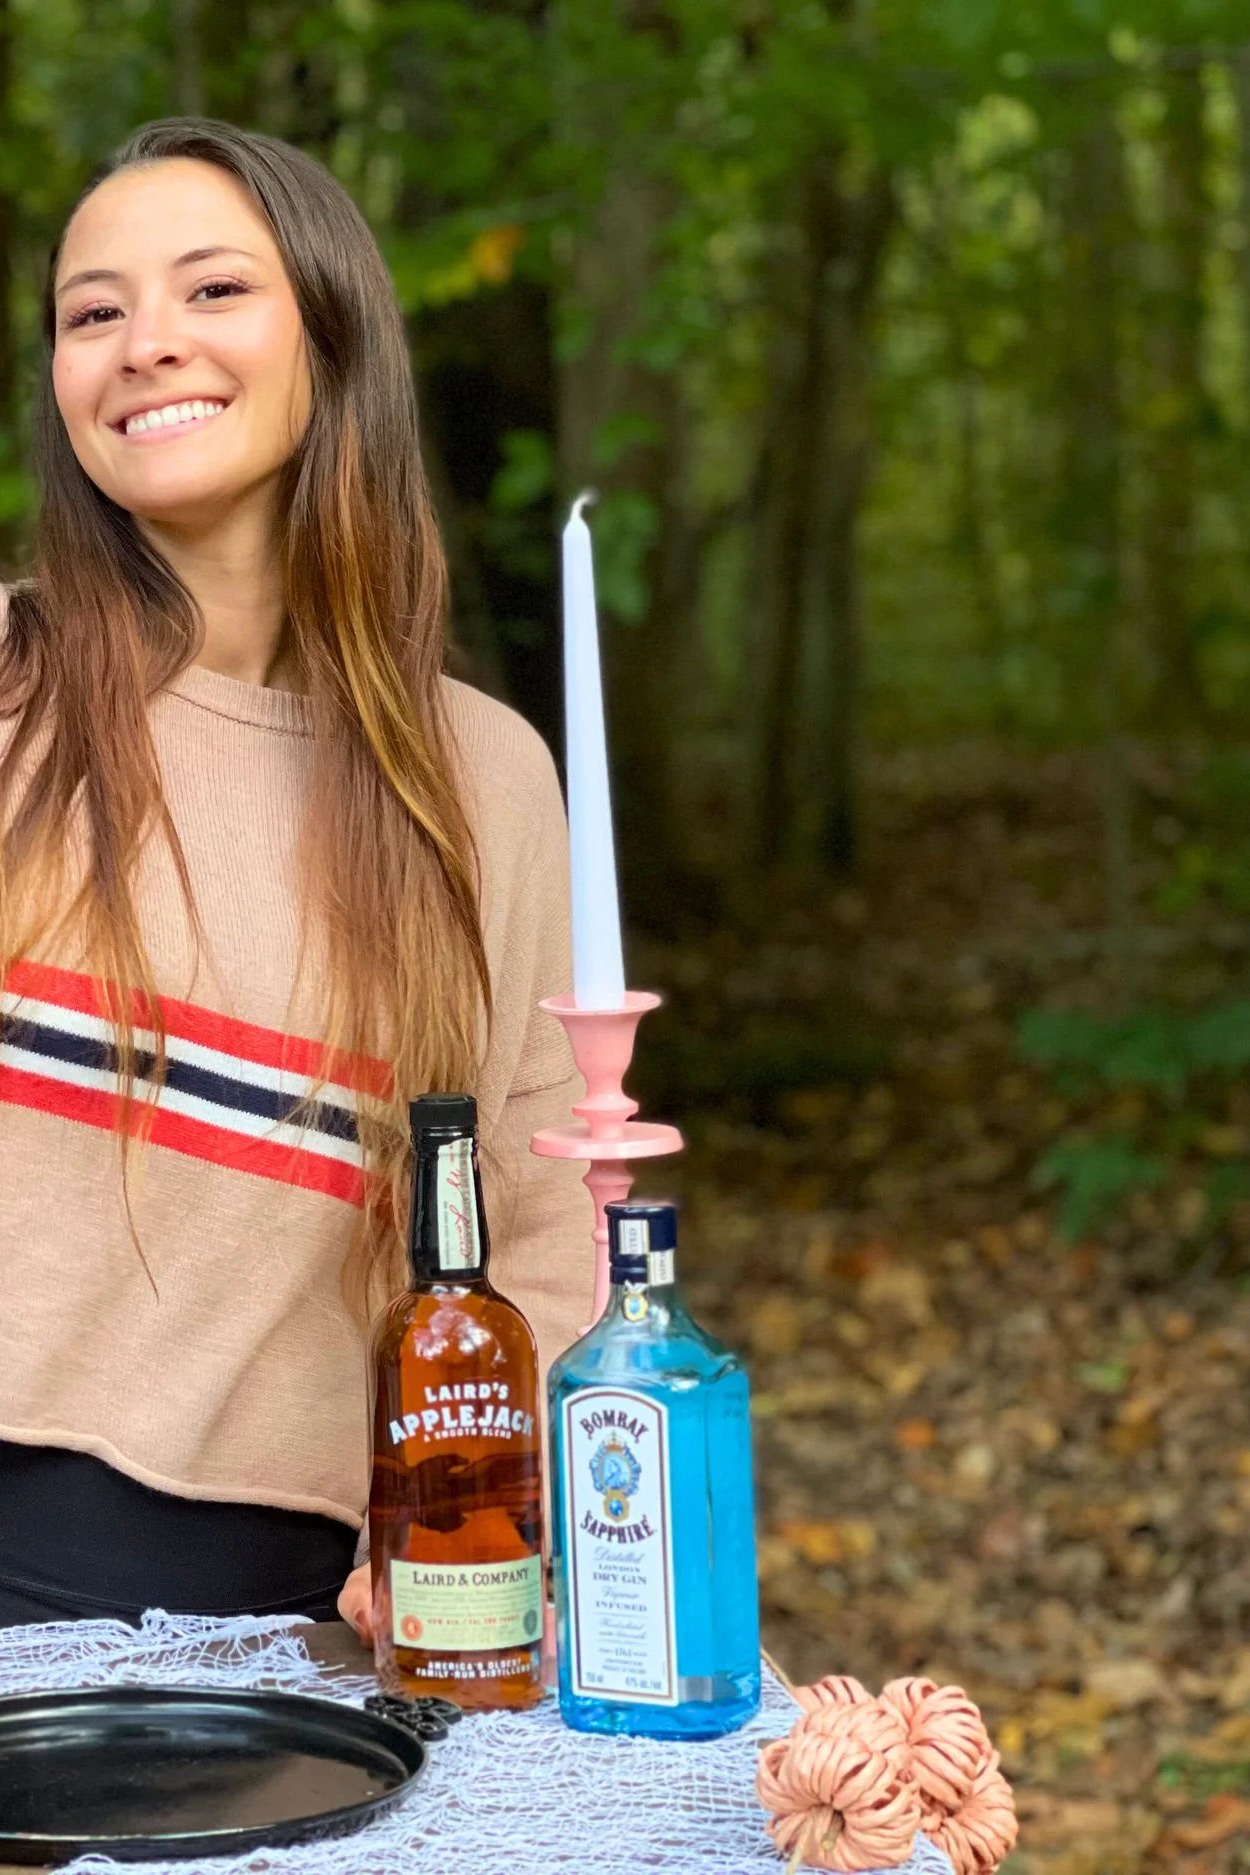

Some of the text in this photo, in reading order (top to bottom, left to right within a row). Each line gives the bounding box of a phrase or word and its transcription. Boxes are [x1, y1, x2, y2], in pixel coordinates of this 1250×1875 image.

[424, 1382, 509, 1403] LAIRD'S
[389, 1405, 534, 1445] APPLEJACK
[580, 1410, 649, 1443] BOMBAY
[580, 1509, 654, 1543] SAPPHIRE
[413, 1568, 529, 1586] LAIRD & COMPANY
[598, 1563, 640, 1572] LONDON
[592, 1572, 646, 1584] DRY GIN
[595, 1601, 647, 1612] INFUSED
